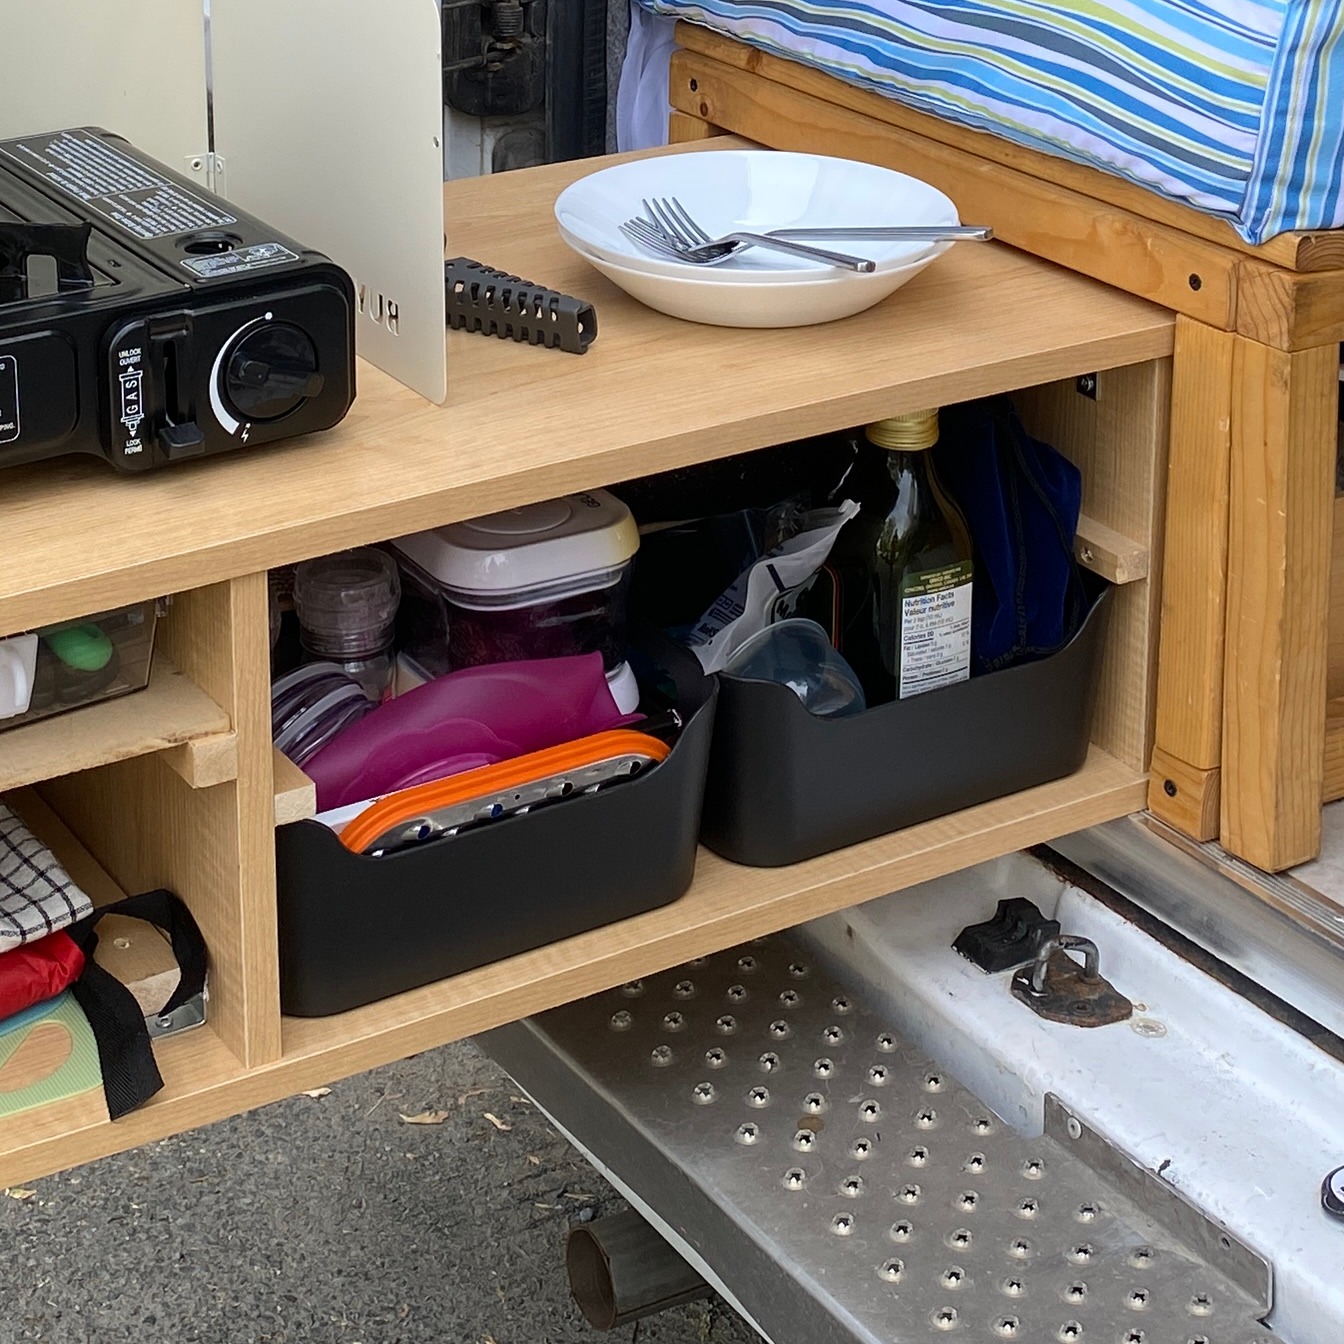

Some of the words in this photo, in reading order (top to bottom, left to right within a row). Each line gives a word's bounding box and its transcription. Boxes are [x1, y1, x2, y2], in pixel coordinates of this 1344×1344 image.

[118, 348, 142, 358] UNLOCK
[126, 380, 138, 413] GAS
[126, 438, 141, 448] LOCK
[905, 596, 935, 607] Nutrition
[937, 592, 954, 601] Facts
[904, 606, 927, 616] Valeur
[928, 600, 955, 612] nutritive
